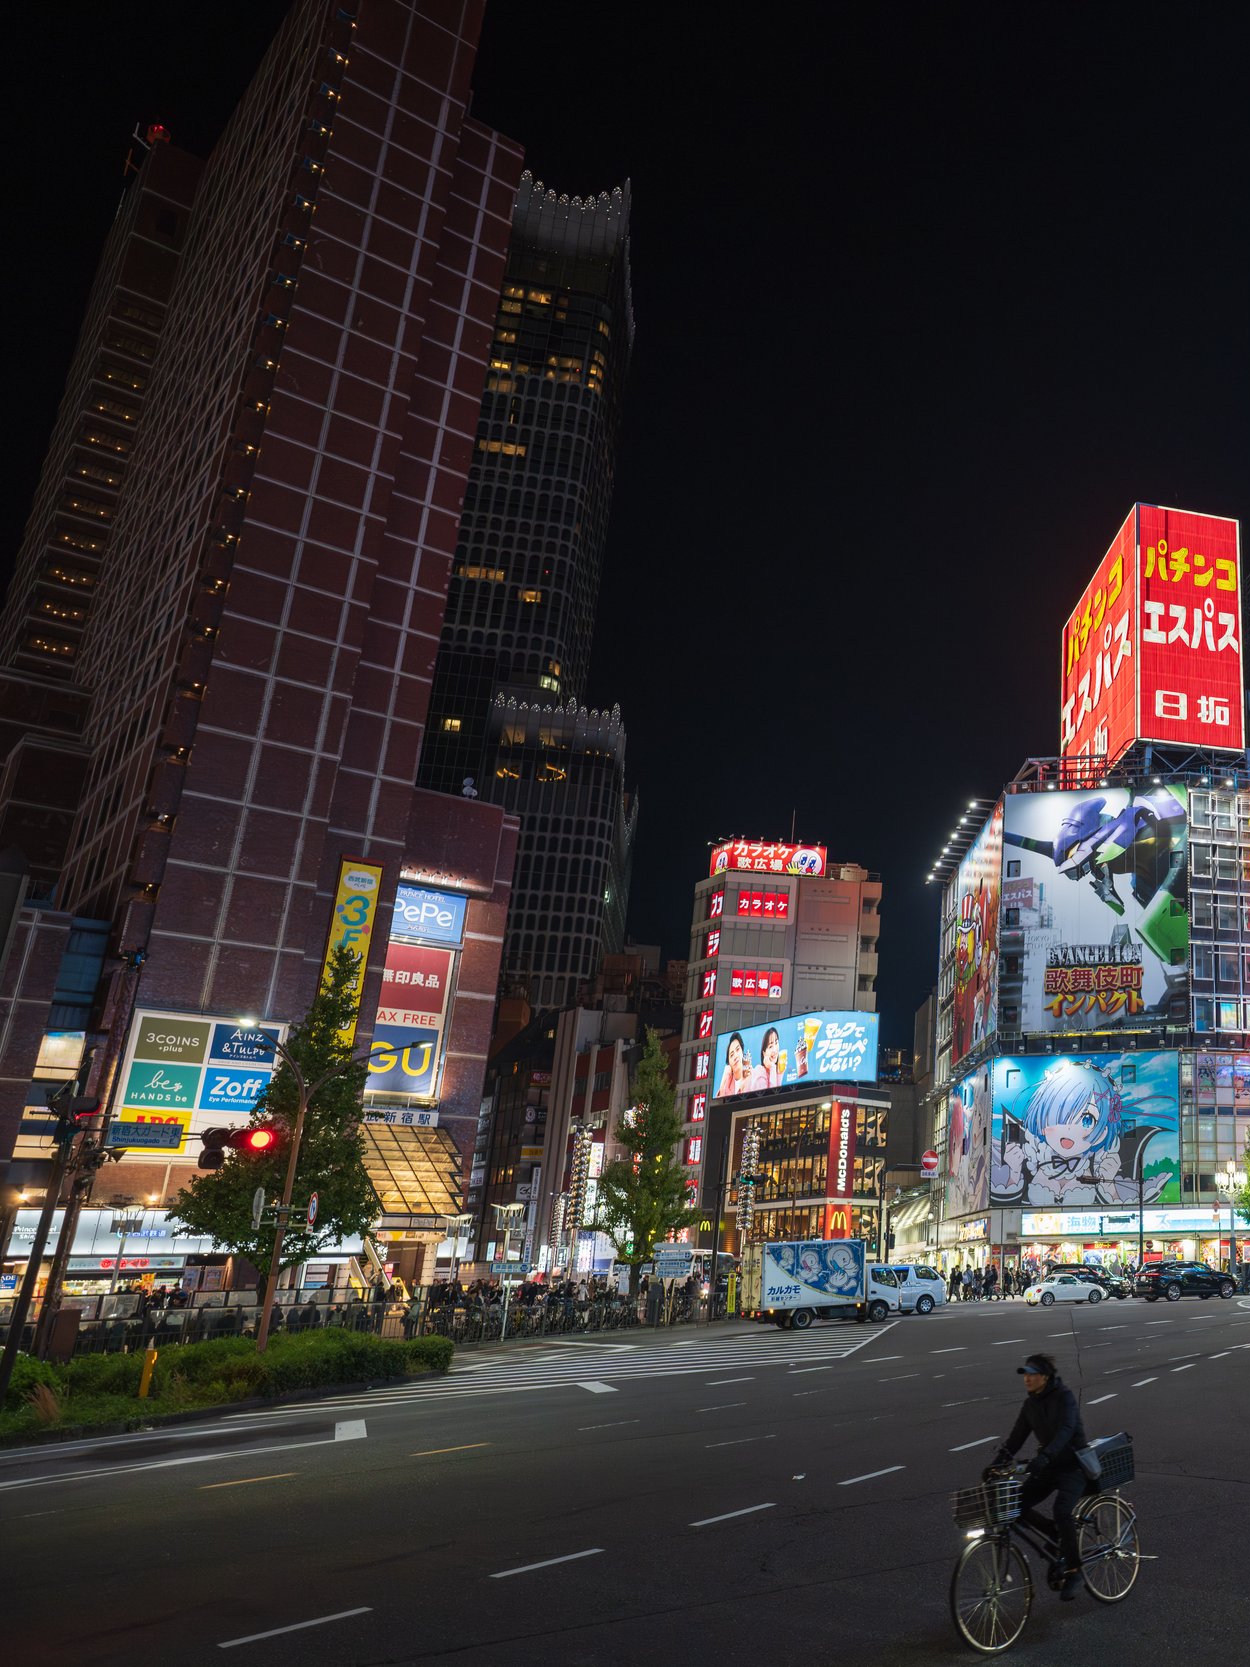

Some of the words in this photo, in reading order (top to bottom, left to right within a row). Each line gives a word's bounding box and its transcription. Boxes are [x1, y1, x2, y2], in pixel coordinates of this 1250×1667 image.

[1144, 539, 1236, 592] パチンコ
[1067, 553, 1123, 677] パチンコ
[1143, 598, 1239, 654] エスパス
[1061, 608, 1132, 748] エスパス
[1155, 690, 1230, 726] 日拓
[733, 841, 793, 859] カラオケ
[737, 856, 783, 871] 歌広場
[394, 899, 453, 927] PePe
[739, 898, 788, 911] カラオケ
[1046, 942, 1144, 966] EVANGELION
[383, 968, 440, 989] 無印良品
[732, 977, 768, 990] 歌広場
[1045, 966, 1144, 992] 歌舞伎町
[1044, 990, 1145, 1018] インパクト
[403, 1013, 437, 1026] FREE
[825, 1022, 865, 1038] マックで
[146, 1032, 200, 1047] 3COINS
[230, 1028, 264, 1042] AINZ
[367, 1041, 431, 1077] GU
[816, 1038, 868, 1060] フラッペ
[131, 1092, 171, 1102] HANDS
[175, 1094, 187, 1102] be
[210, 1076, 262, 1097] Zoff
[208, 1096, 220, 1104] Eye
[112, 1125, 180, 1138] 新宿大ガード東
[837, 1108, 851, 1192] McDonald's
[767, 1285, 801, 1296] カルガモ
